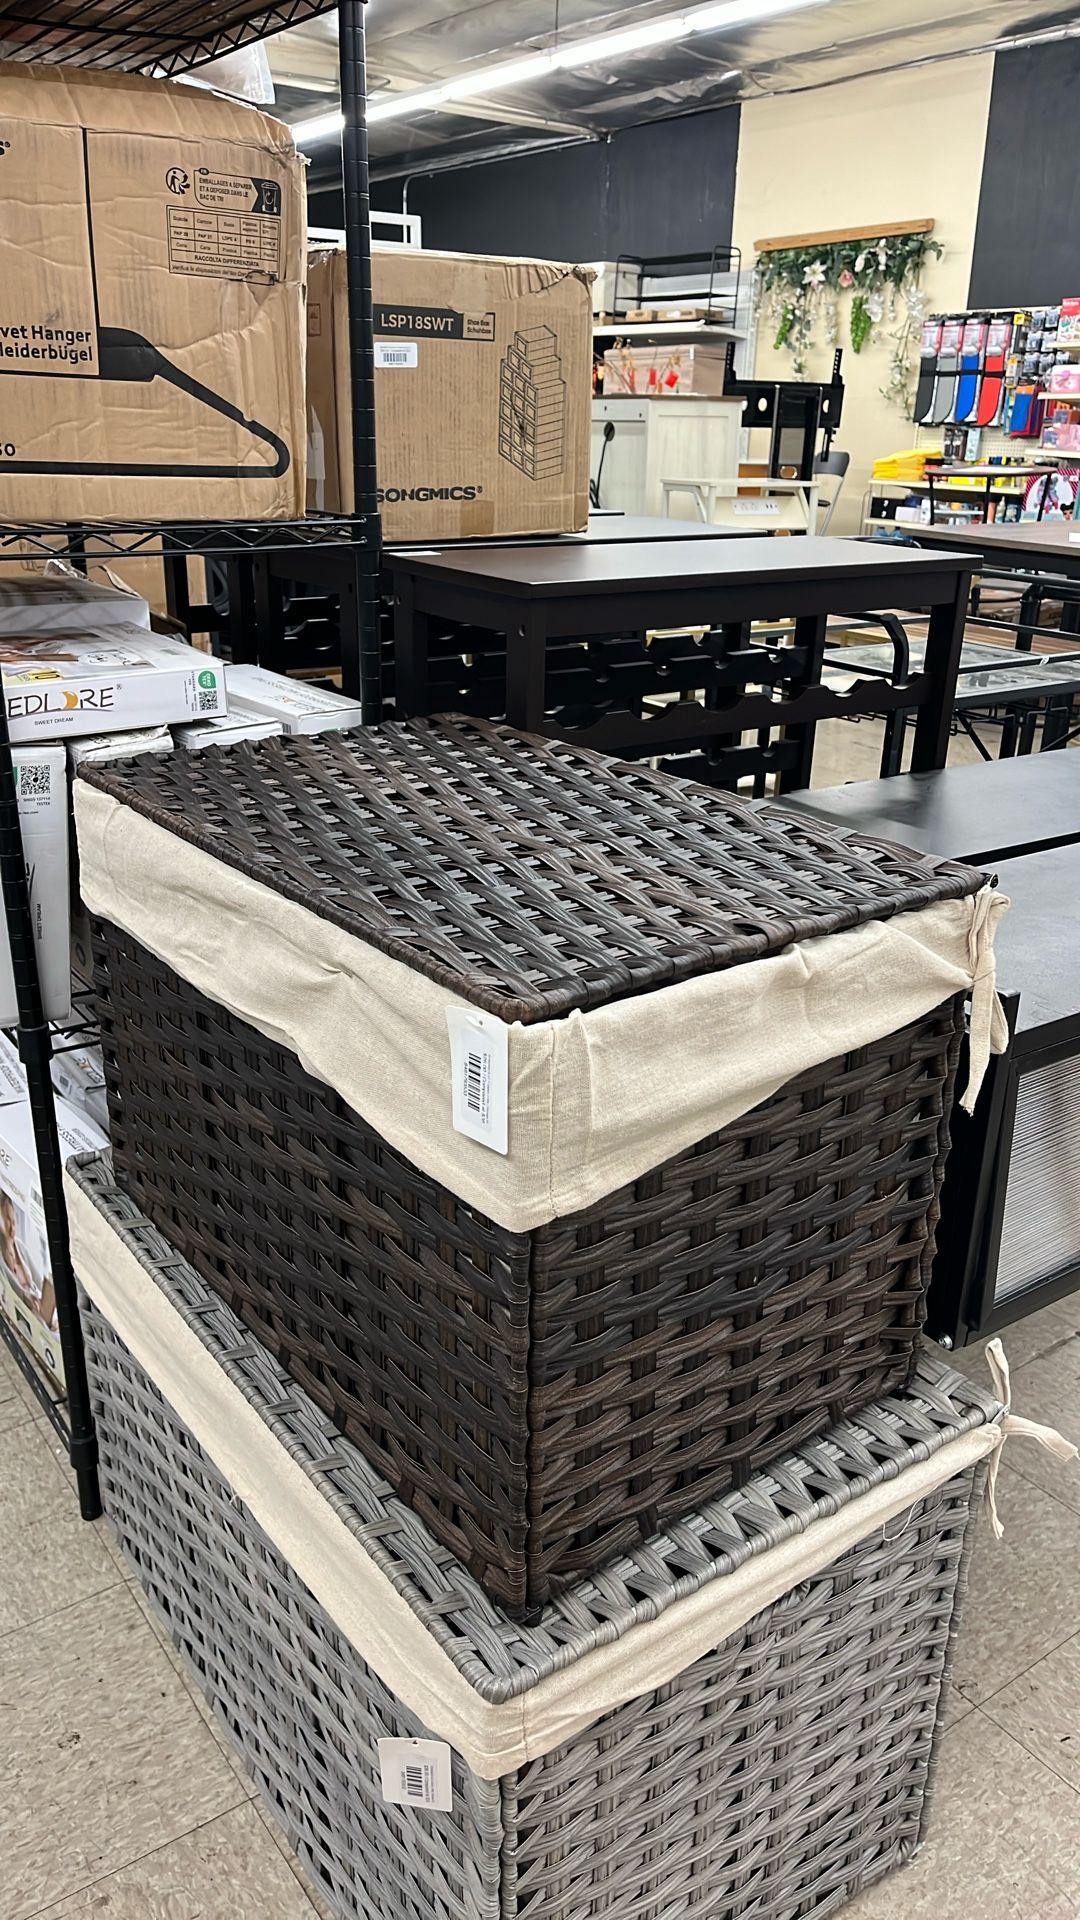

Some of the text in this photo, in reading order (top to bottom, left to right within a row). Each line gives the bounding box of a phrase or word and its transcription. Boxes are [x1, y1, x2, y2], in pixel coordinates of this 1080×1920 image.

[195, 255, 222, 263] RACCOLTA
[381, 313, 455, 332] LSP18SWT
[0, 325, 91, 346] vet Hanger
[0, 342, 93, 364] leiderbügel
[0, 442, 16, 457] 0
